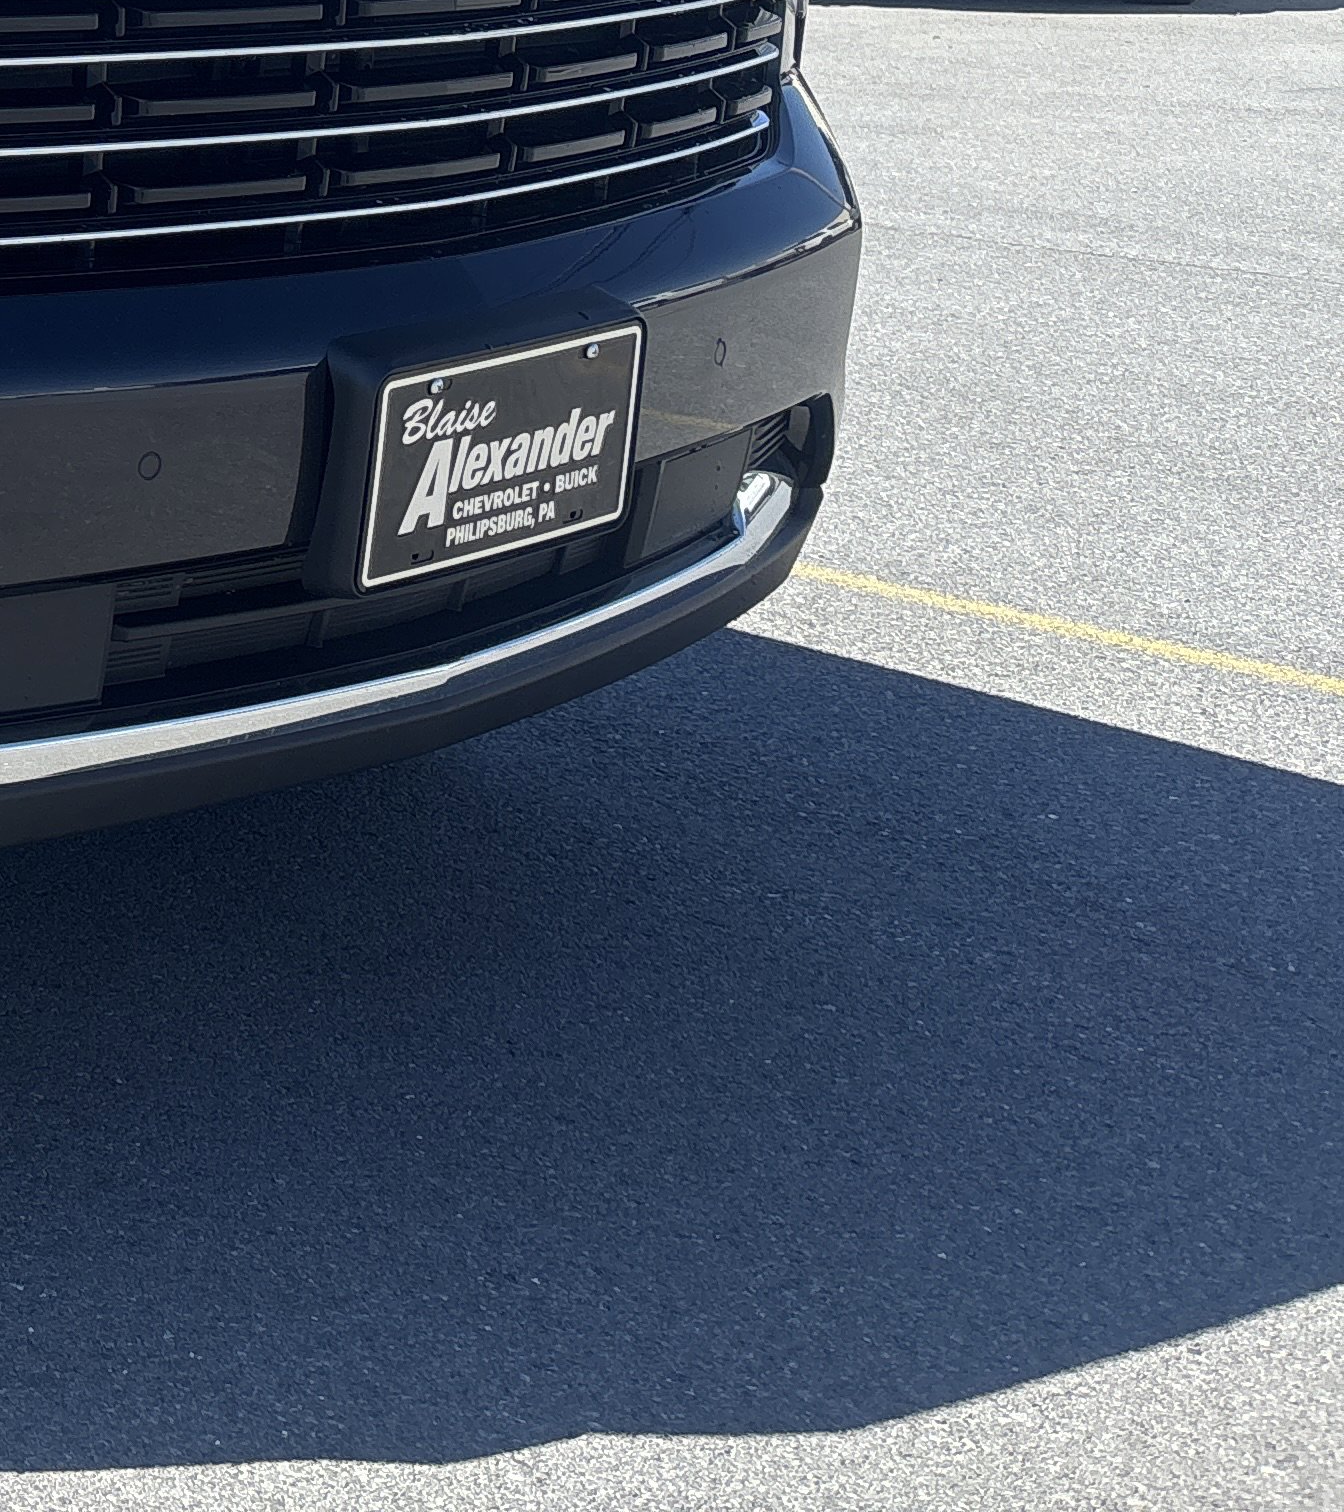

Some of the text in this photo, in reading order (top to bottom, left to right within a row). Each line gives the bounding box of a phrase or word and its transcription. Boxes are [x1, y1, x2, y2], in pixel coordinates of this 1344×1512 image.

[402, 398, 497, 445] Blaise
[397, 407, 616, 537] Alexander
[452, 465, 599, 520] CHEVROLET BUICK
[445, 501, 556, 548] PHILIPSBURG, PA
